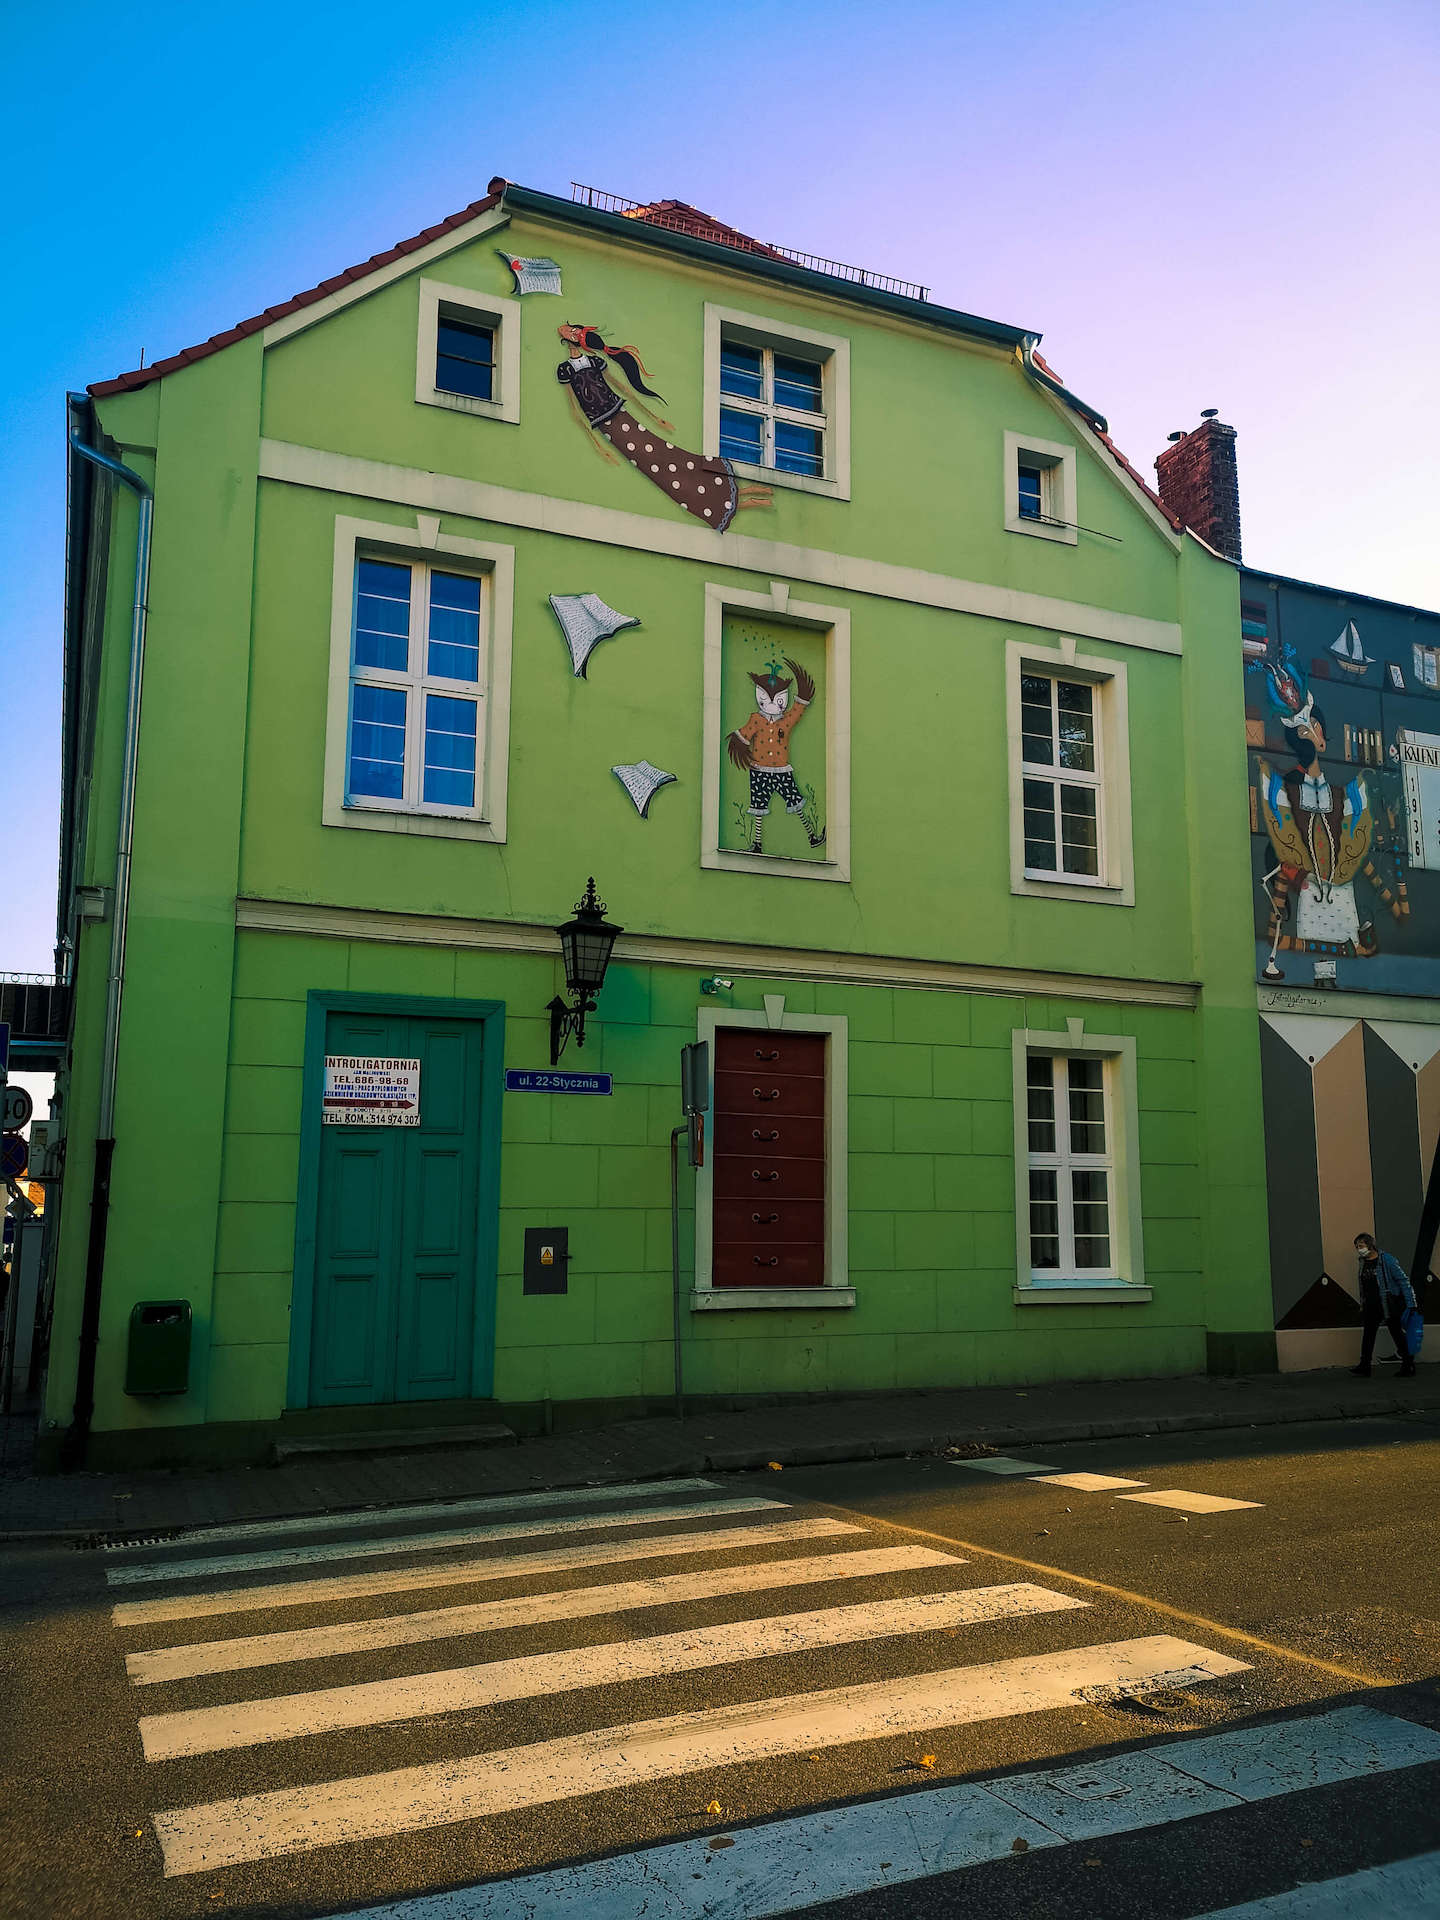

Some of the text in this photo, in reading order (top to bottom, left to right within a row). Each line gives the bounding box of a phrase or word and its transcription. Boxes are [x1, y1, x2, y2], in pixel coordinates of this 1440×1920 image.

[325, 1057, 418, 1070] INTROLIGATORNIA
[519, 1076, 599, 1089] ul. 22-Stycznia
[387, 1115, 402, 1124] 974
[404, 1116, 418, 1124] 307
